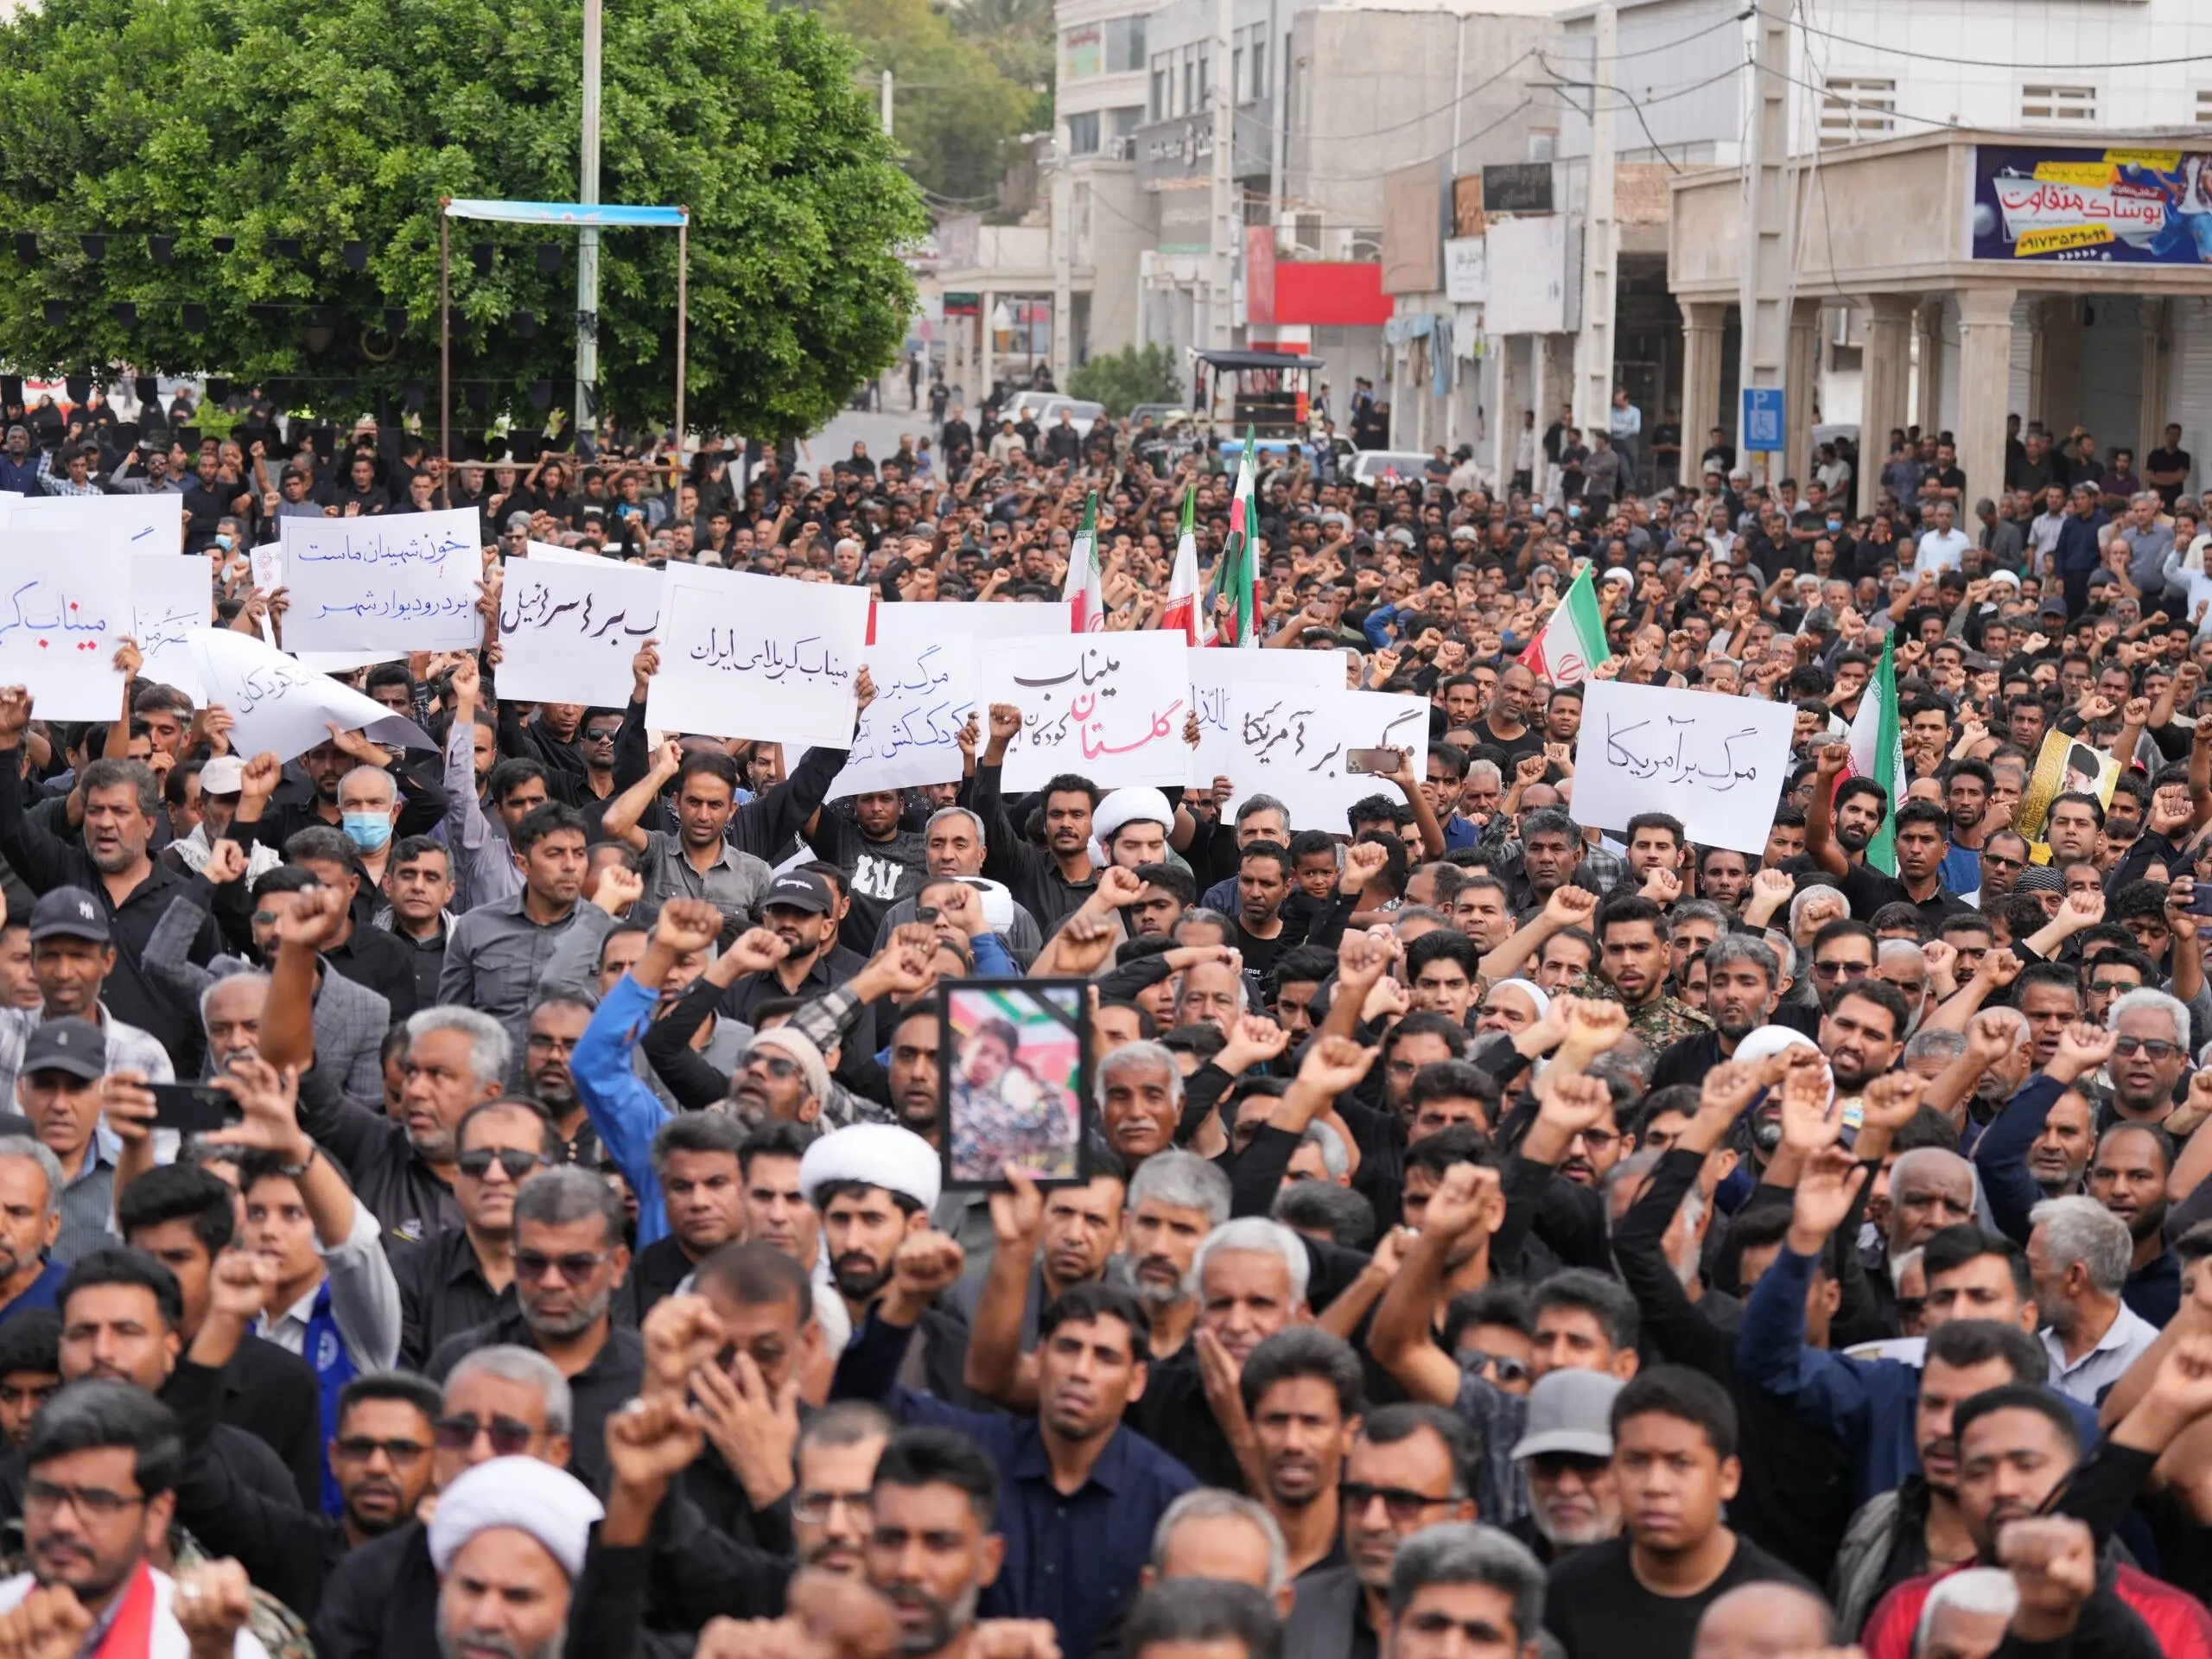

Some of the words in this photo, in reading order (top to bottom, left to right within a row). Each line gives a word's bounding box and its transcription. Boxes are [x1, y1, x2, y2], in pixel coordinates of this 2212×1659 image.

[2001, 184, 2084, 216] متفاوت
[2083, 199, 2162, 228] پوشاک
[1754, 391, 1769, 410] P
[298, 534, 362, 562] ماست
[363, 533, 418, 566] شهیدان
[25, 594, 106, 651] میناب
[310, 590, 377, 619] شهر
[500, 581, 593, 635] اسرائیل
[589, 608, 626, 645] بر
[690, 627, 734, 671] ایران
[799, 649, 849, 685] میناب
[903, 645, 949, 695] مرگ
[1013, 648, 1121, 701] میناب
[881, 707, 921, 758] کش
[1025, 712, 1071, 747] کودکان
[1070, 692, 1184, 760] گلستان
[1243, 701, 1316, 765] آمریکا
[1308, 742, 1341, 778] بر
[1606, 712, 1695, 779] آمریکا
[1699, 728, 1758, 791] مرگ
[1669, 763, 1697, 784] بر
